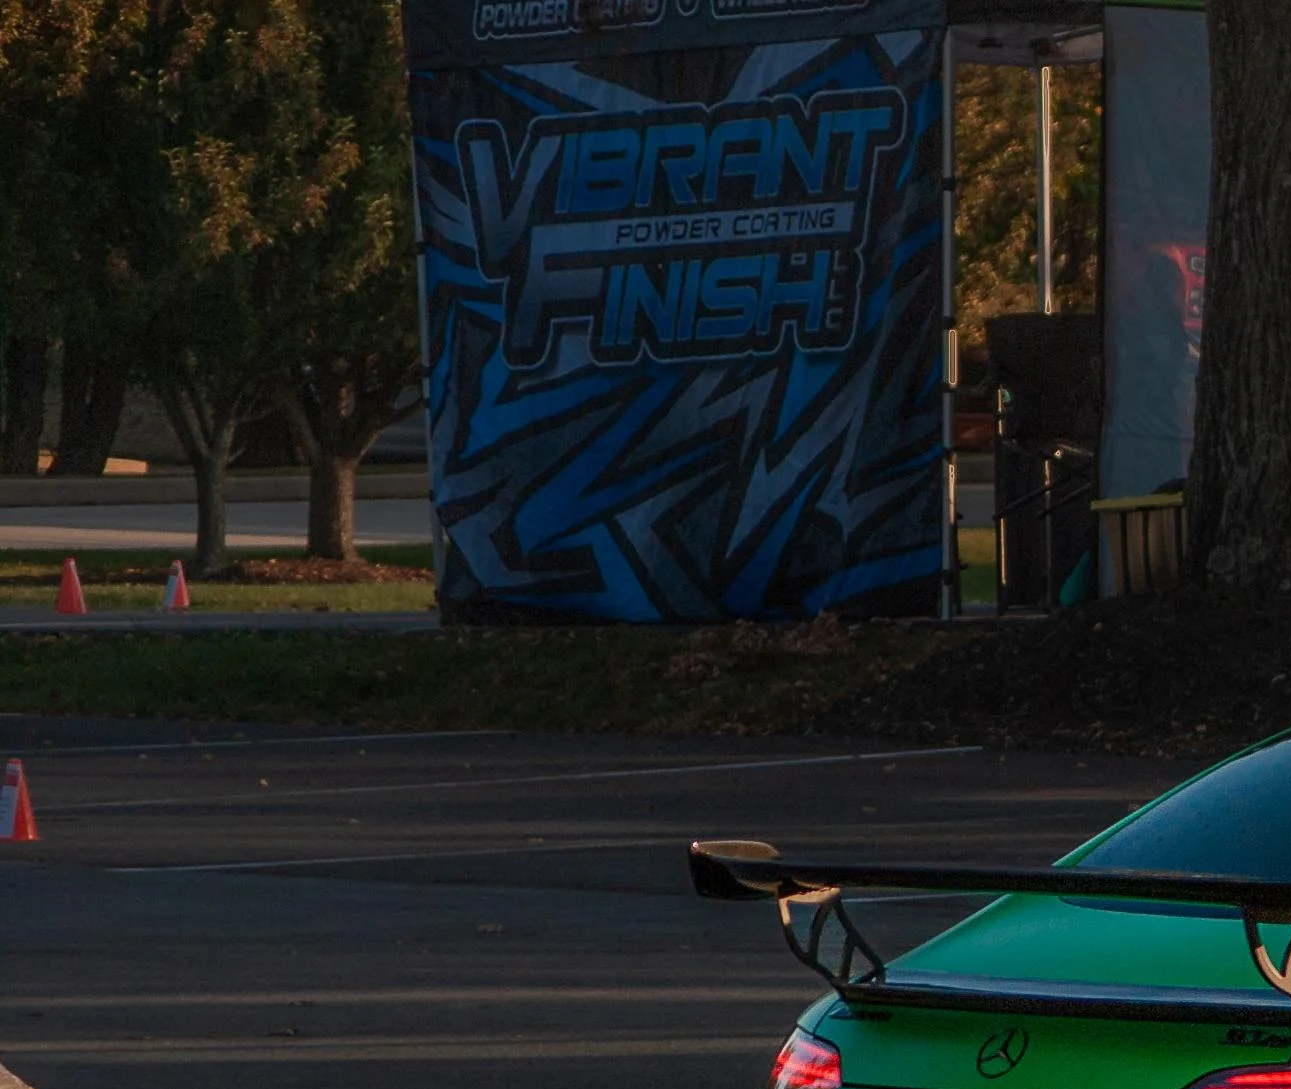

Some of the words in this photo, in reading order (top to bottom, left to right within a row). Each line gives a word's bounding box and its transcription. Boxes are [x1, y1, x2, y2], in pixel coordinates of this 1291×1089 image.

[480, 0, 567, 28] POWDER
[468, 106, 894, 262] VIBRANT
[616, 217, 722, 244] POWDER
[732, 208, 836, 236] COATING
[510, 222, 832, 348] FINISH
